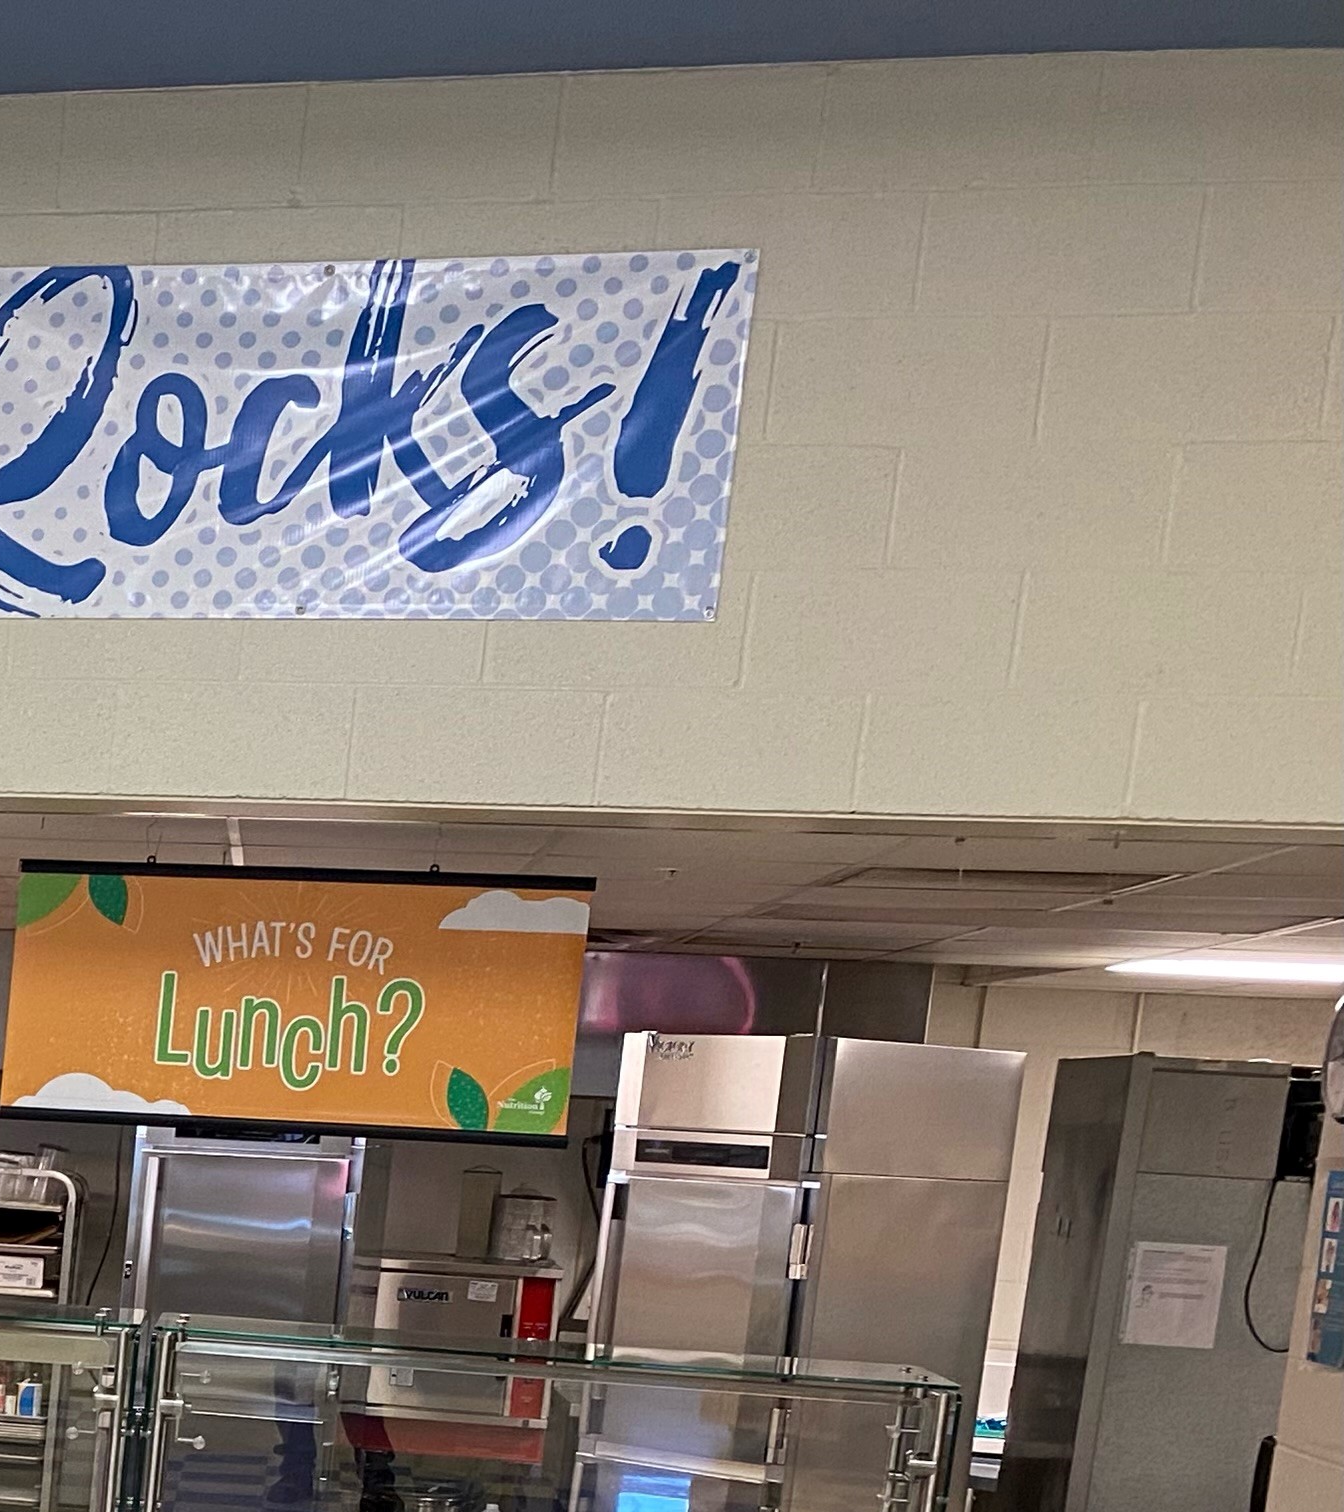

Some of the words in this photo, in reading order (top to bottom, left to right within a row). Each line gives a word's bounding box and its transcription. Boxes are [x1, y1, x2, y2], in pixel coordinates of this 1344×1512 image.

[193, 920, 316, 967] WHAT'S
[327, 926, 394, 975] FOR
[153, 971, 425, 1092] Lunch?
[403, 1289, 449, 1302] VULCAN
